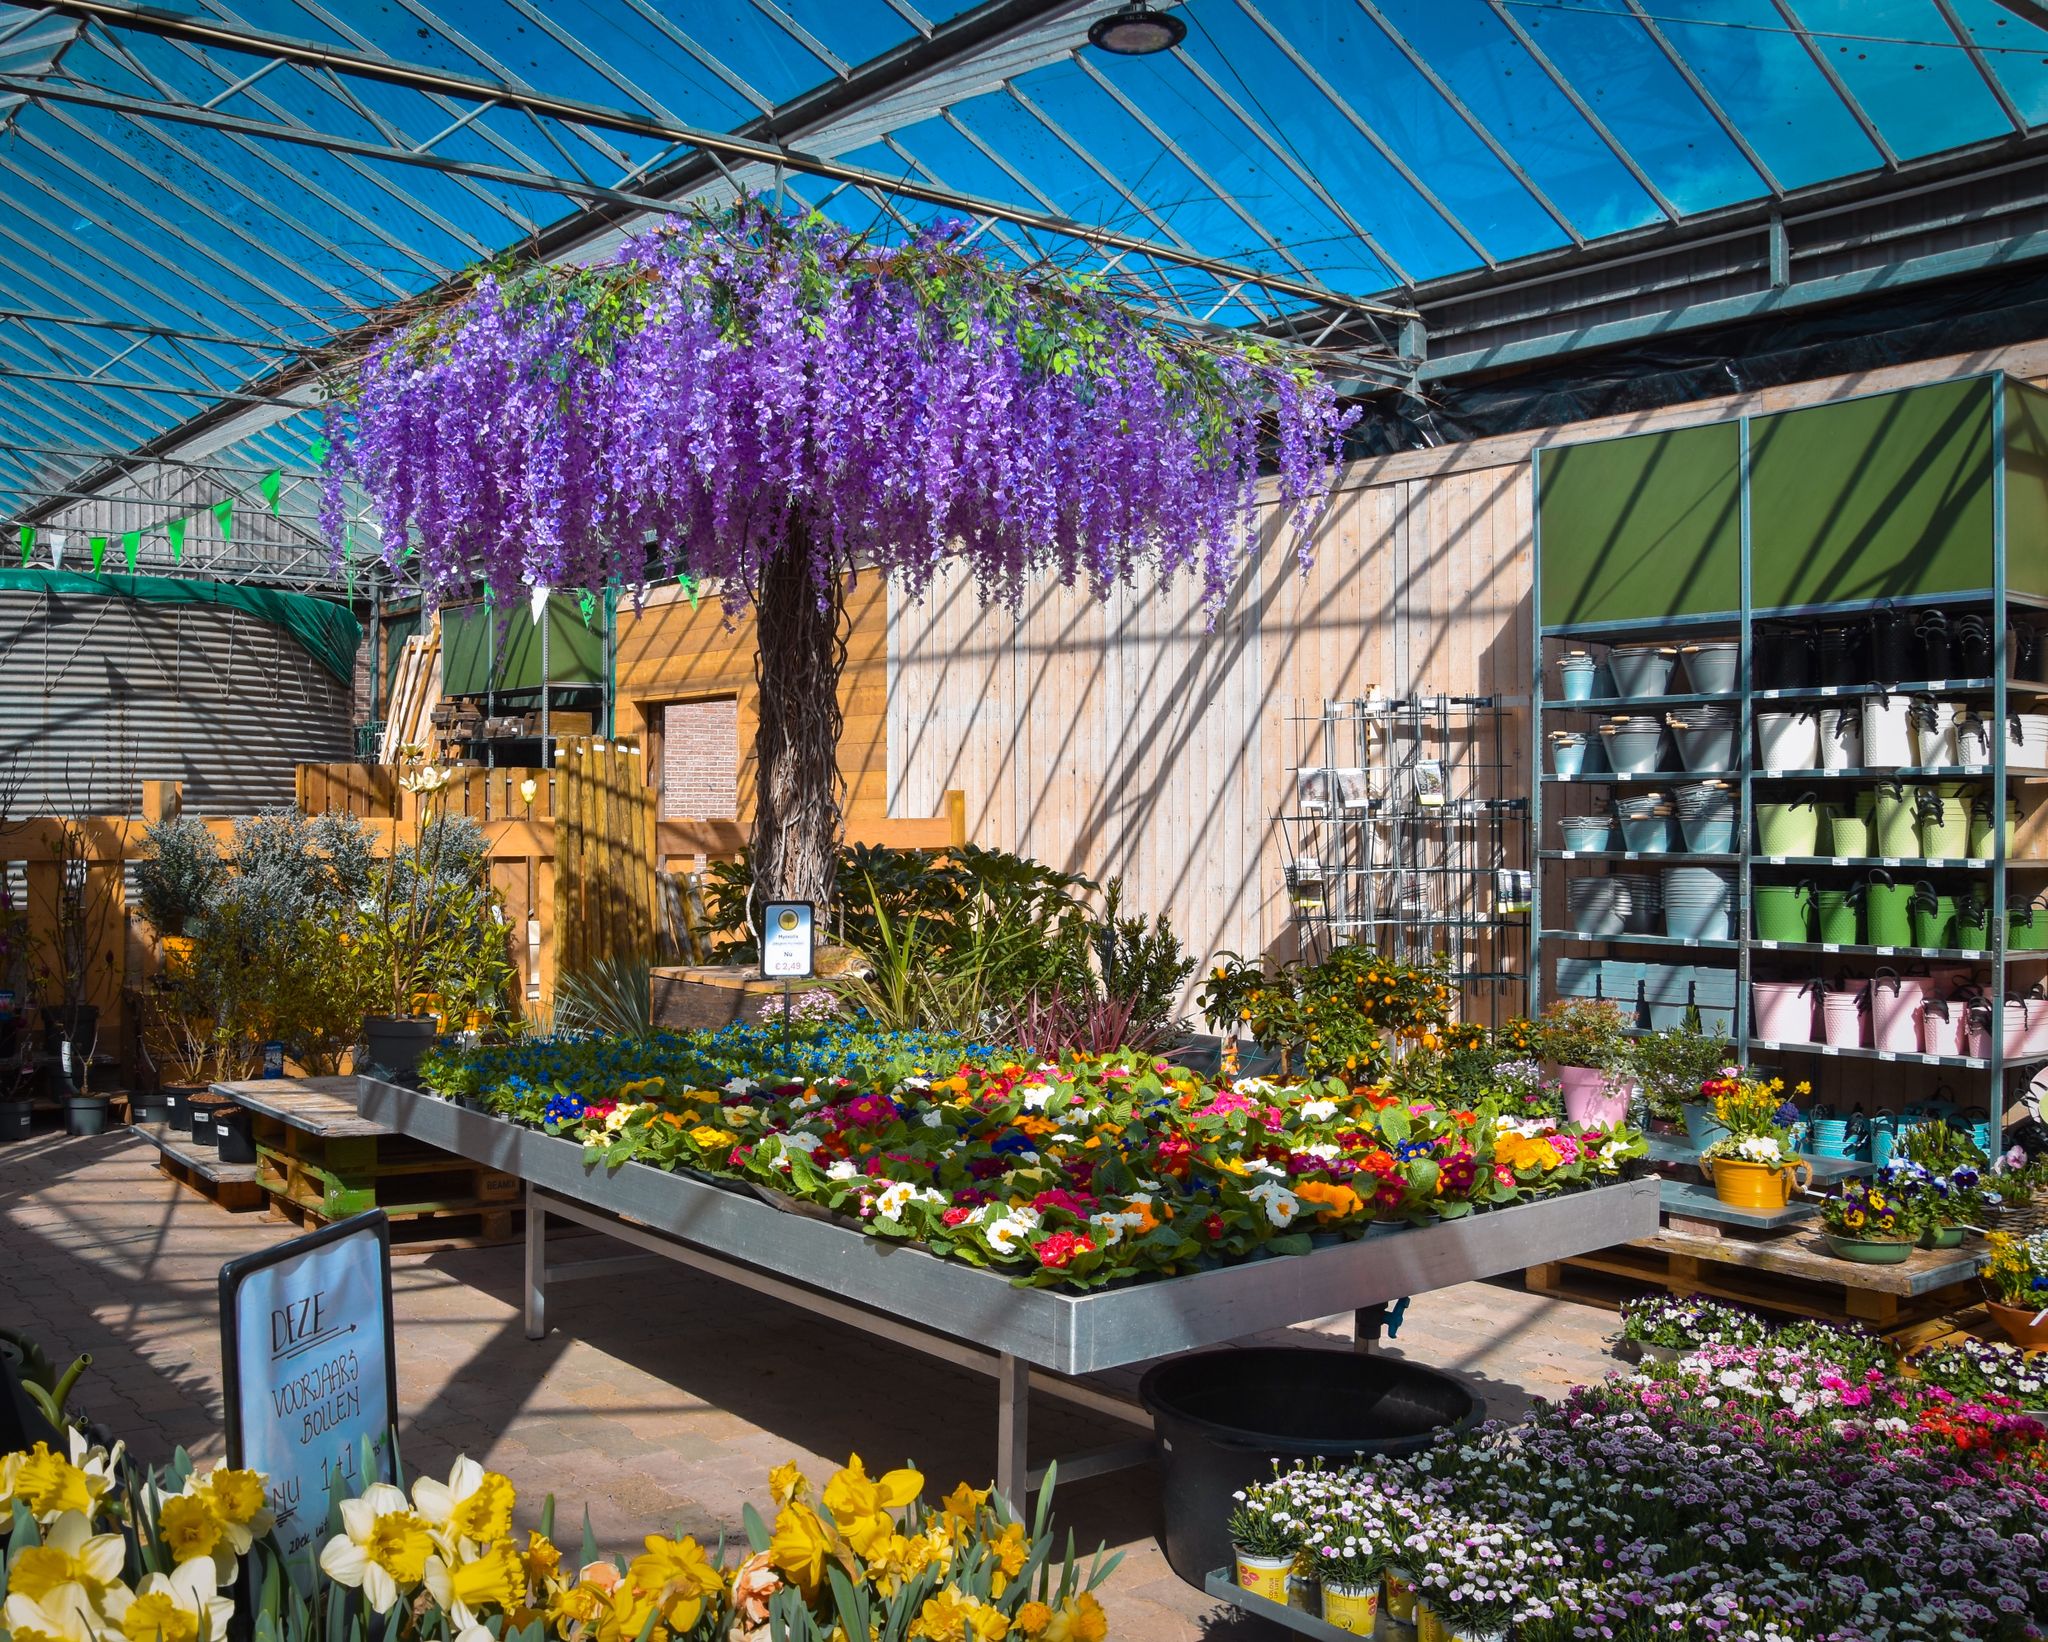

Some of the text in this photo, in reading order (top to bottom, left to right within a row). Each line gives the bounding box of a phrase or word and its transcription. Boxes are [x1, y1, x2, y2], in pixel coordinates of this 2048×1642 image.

[271, 1291, 326, 1353] DEZE
[272, 1349, 360, 1419] VOORJAARS
[300, 1386, 361, 1445] BOLLEN
[273, 1474, 301, 1513] NU
